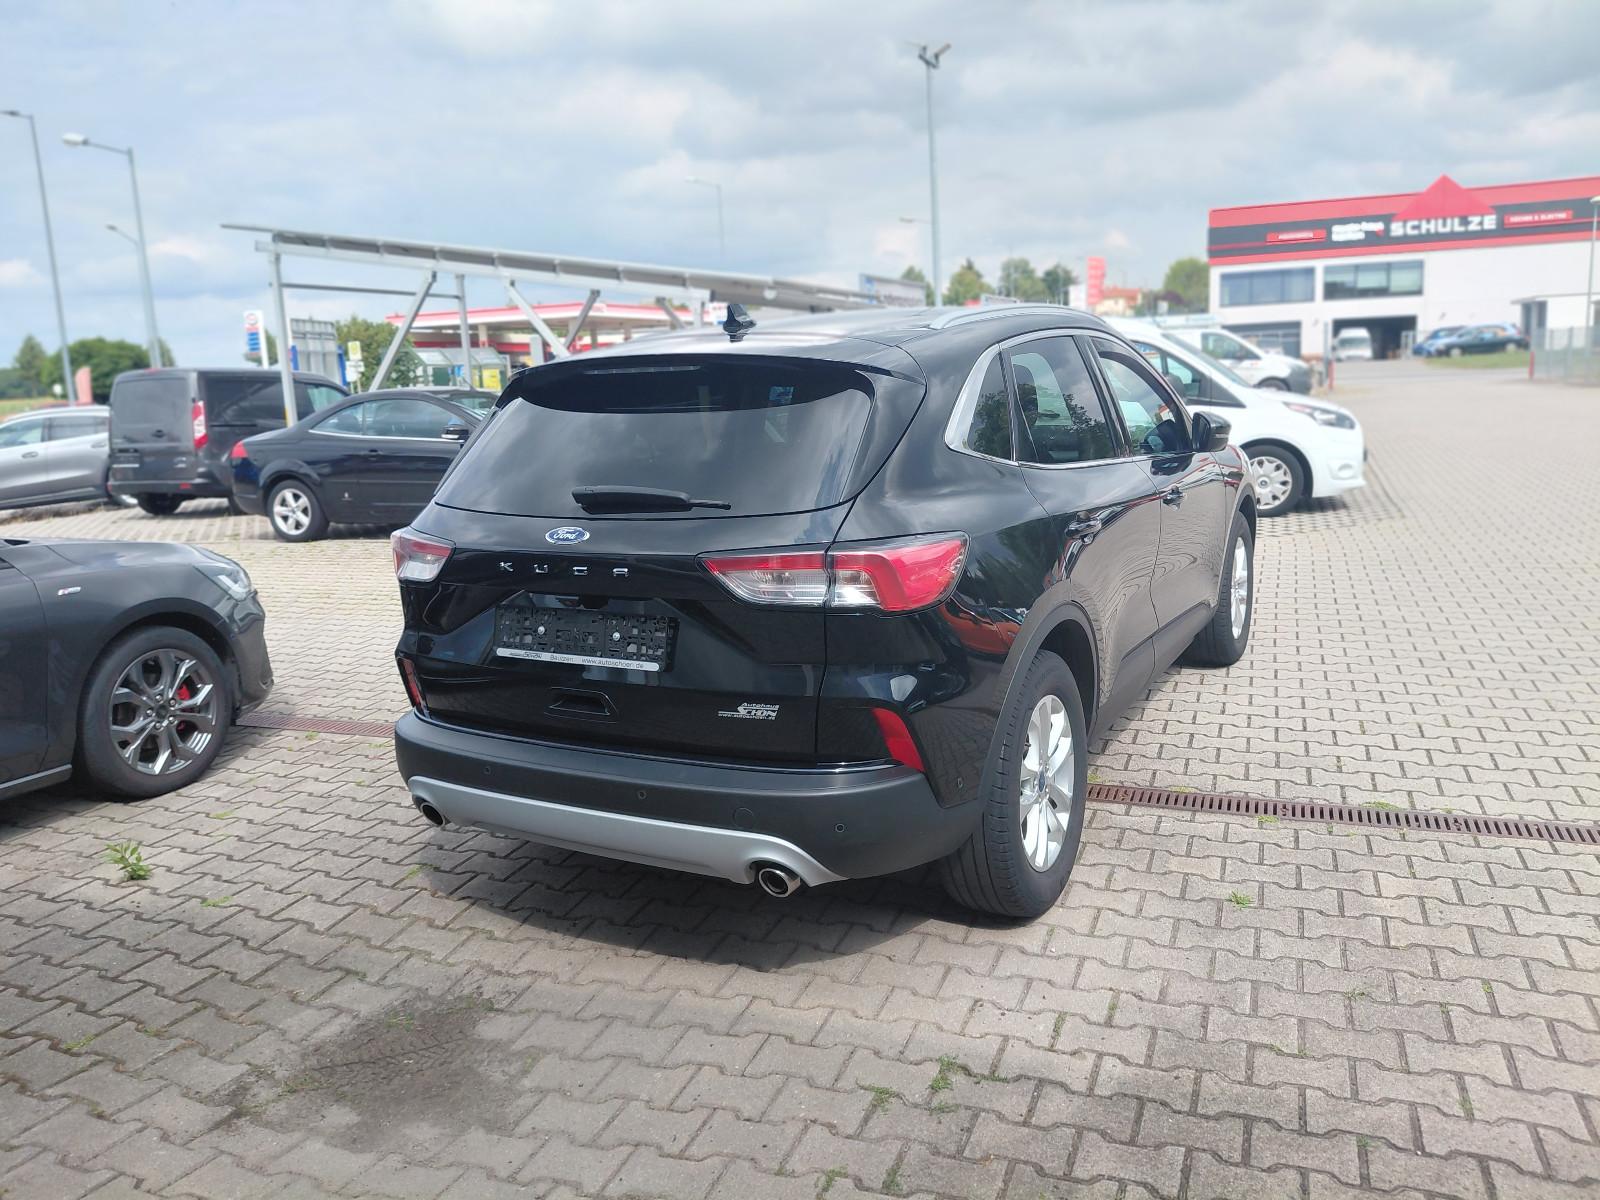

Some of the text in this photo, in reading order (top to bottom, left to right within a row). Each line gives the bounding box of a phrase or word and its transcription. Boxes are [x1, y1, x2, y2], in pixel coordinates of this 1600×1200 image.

[1389, 214, 1497, 237] SCHULZE
[552, 528, 580, 540] Ford
[499, 561, 629, 577] KUGA
